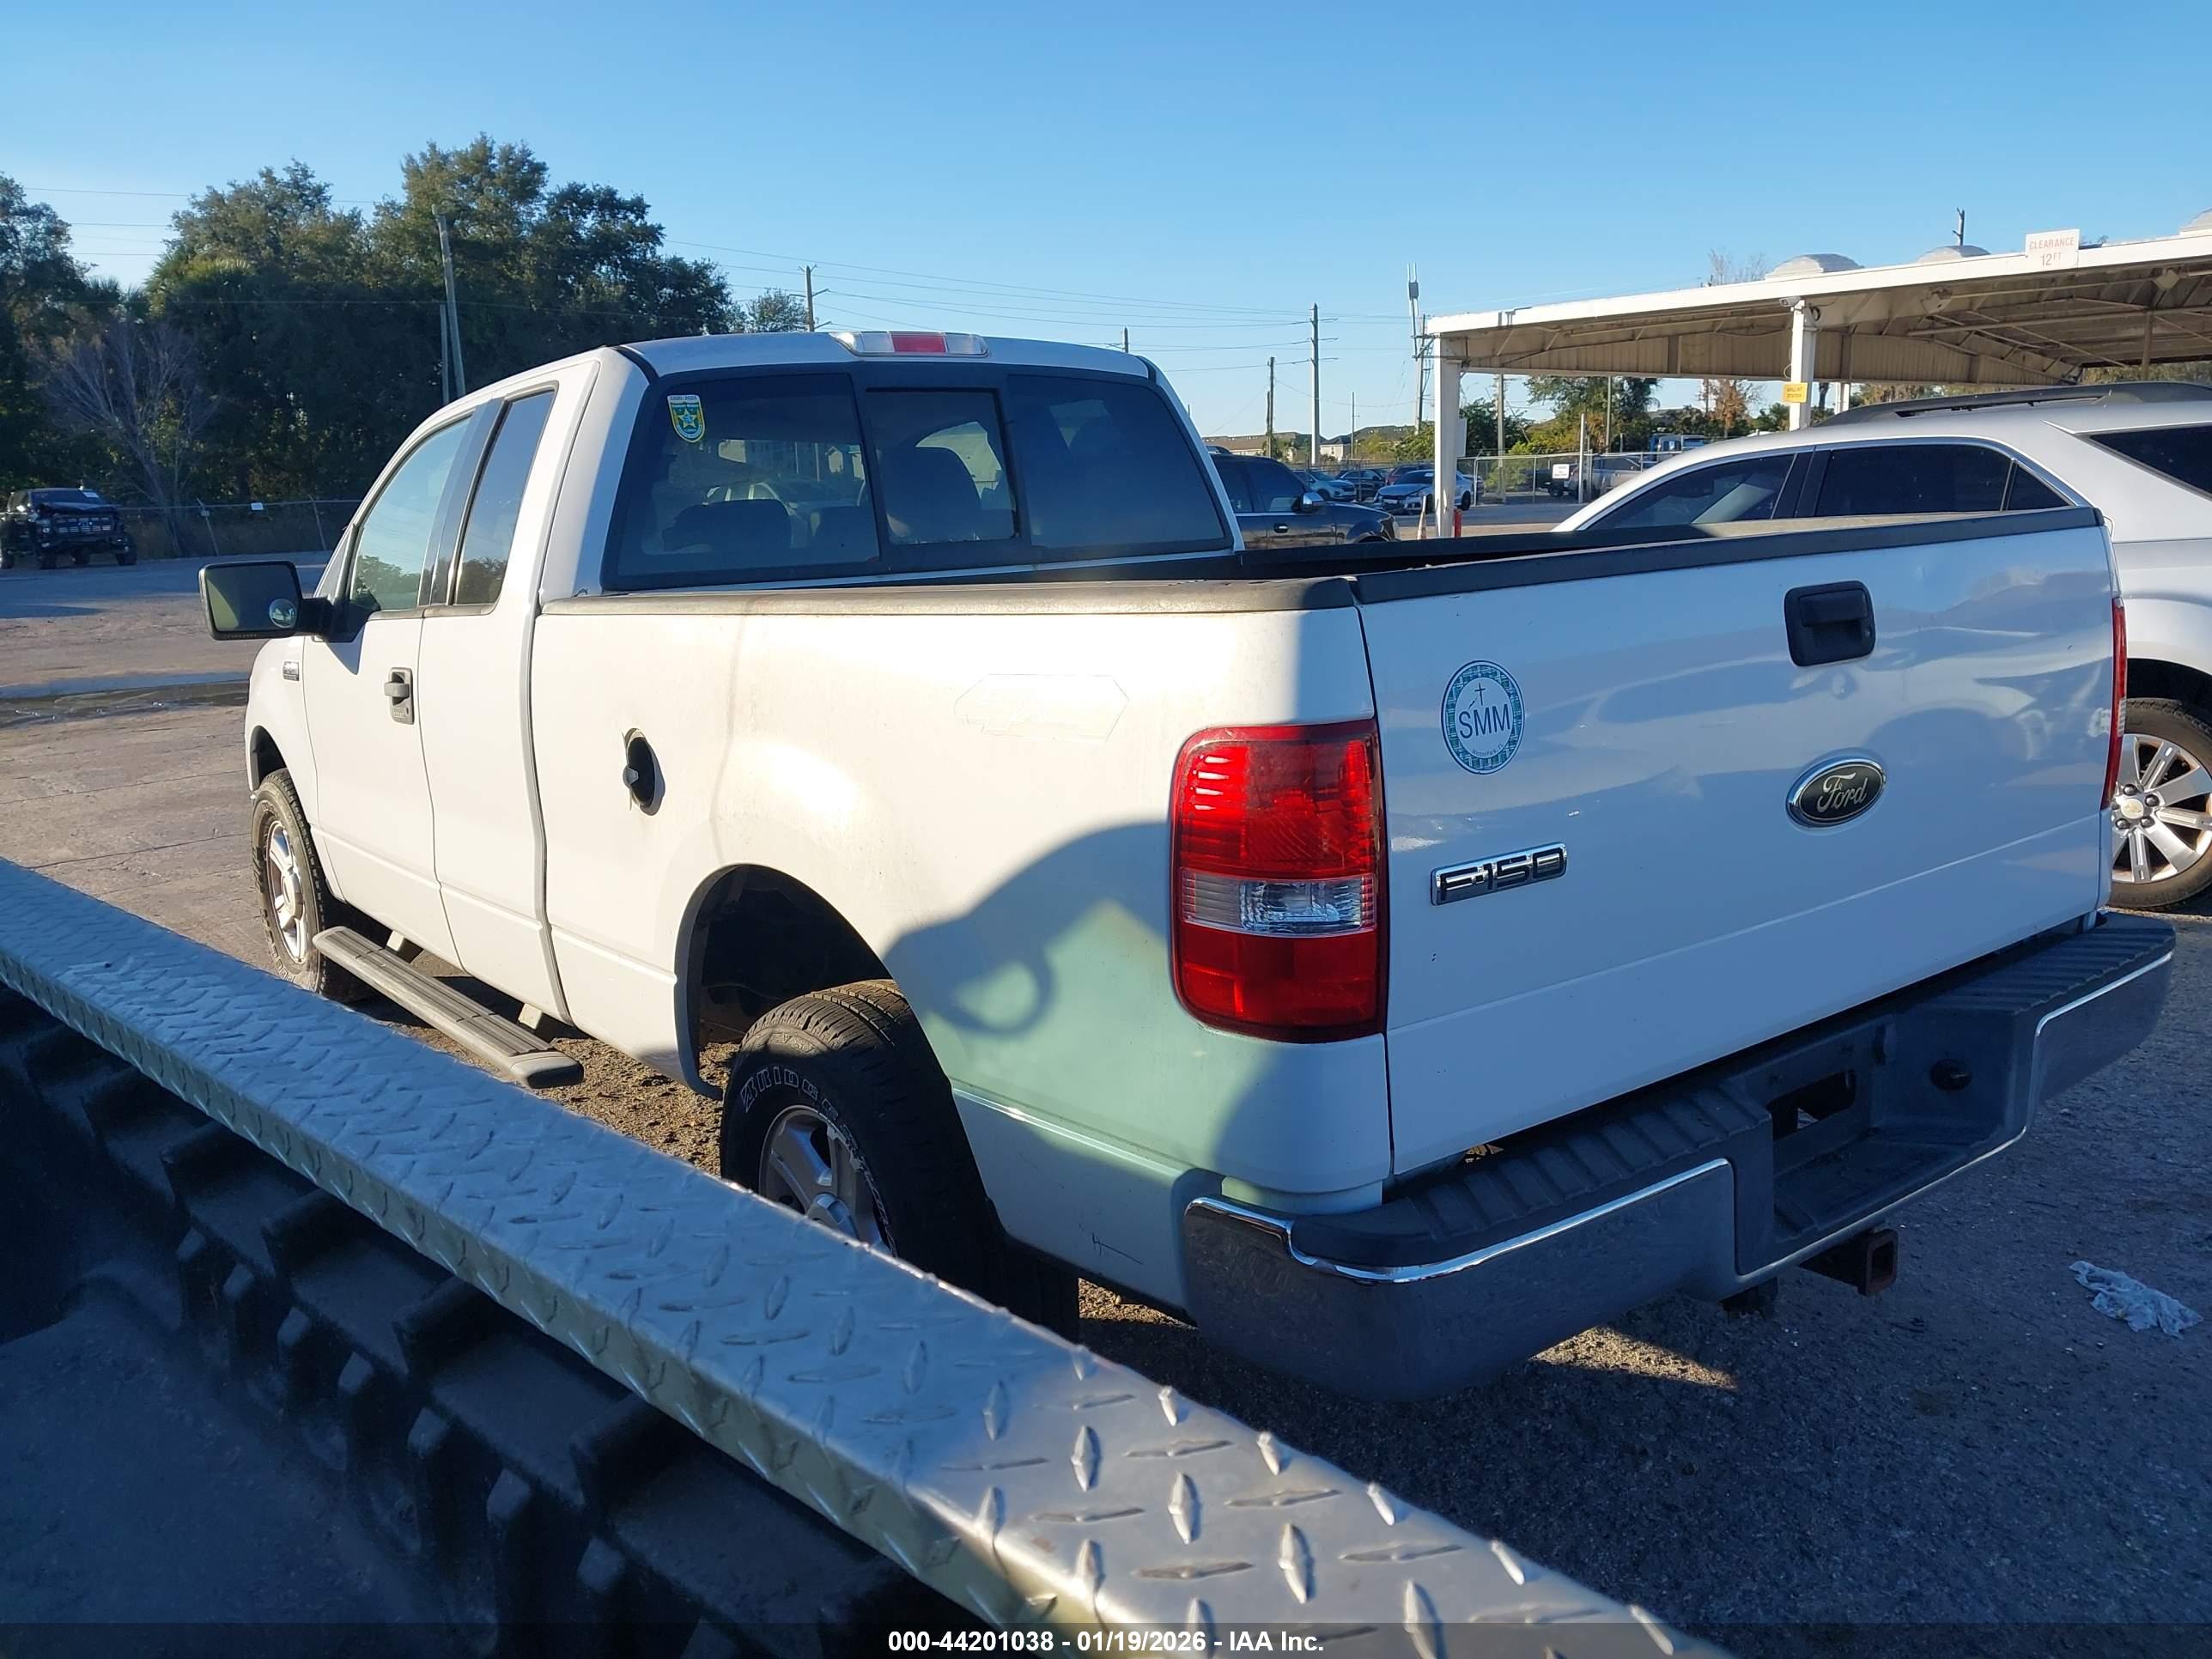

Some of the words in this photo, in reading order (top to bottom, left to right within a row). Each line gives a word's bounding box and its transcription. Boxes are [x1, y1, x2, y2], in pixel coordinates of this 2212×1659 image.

[2028, 236, 2075, 250] CLEARANCE
[2041, 252, 2052, 267] 12
[1458, 703, 1511, 739] SMM
[1816, 772, 1869, 812] Ford
